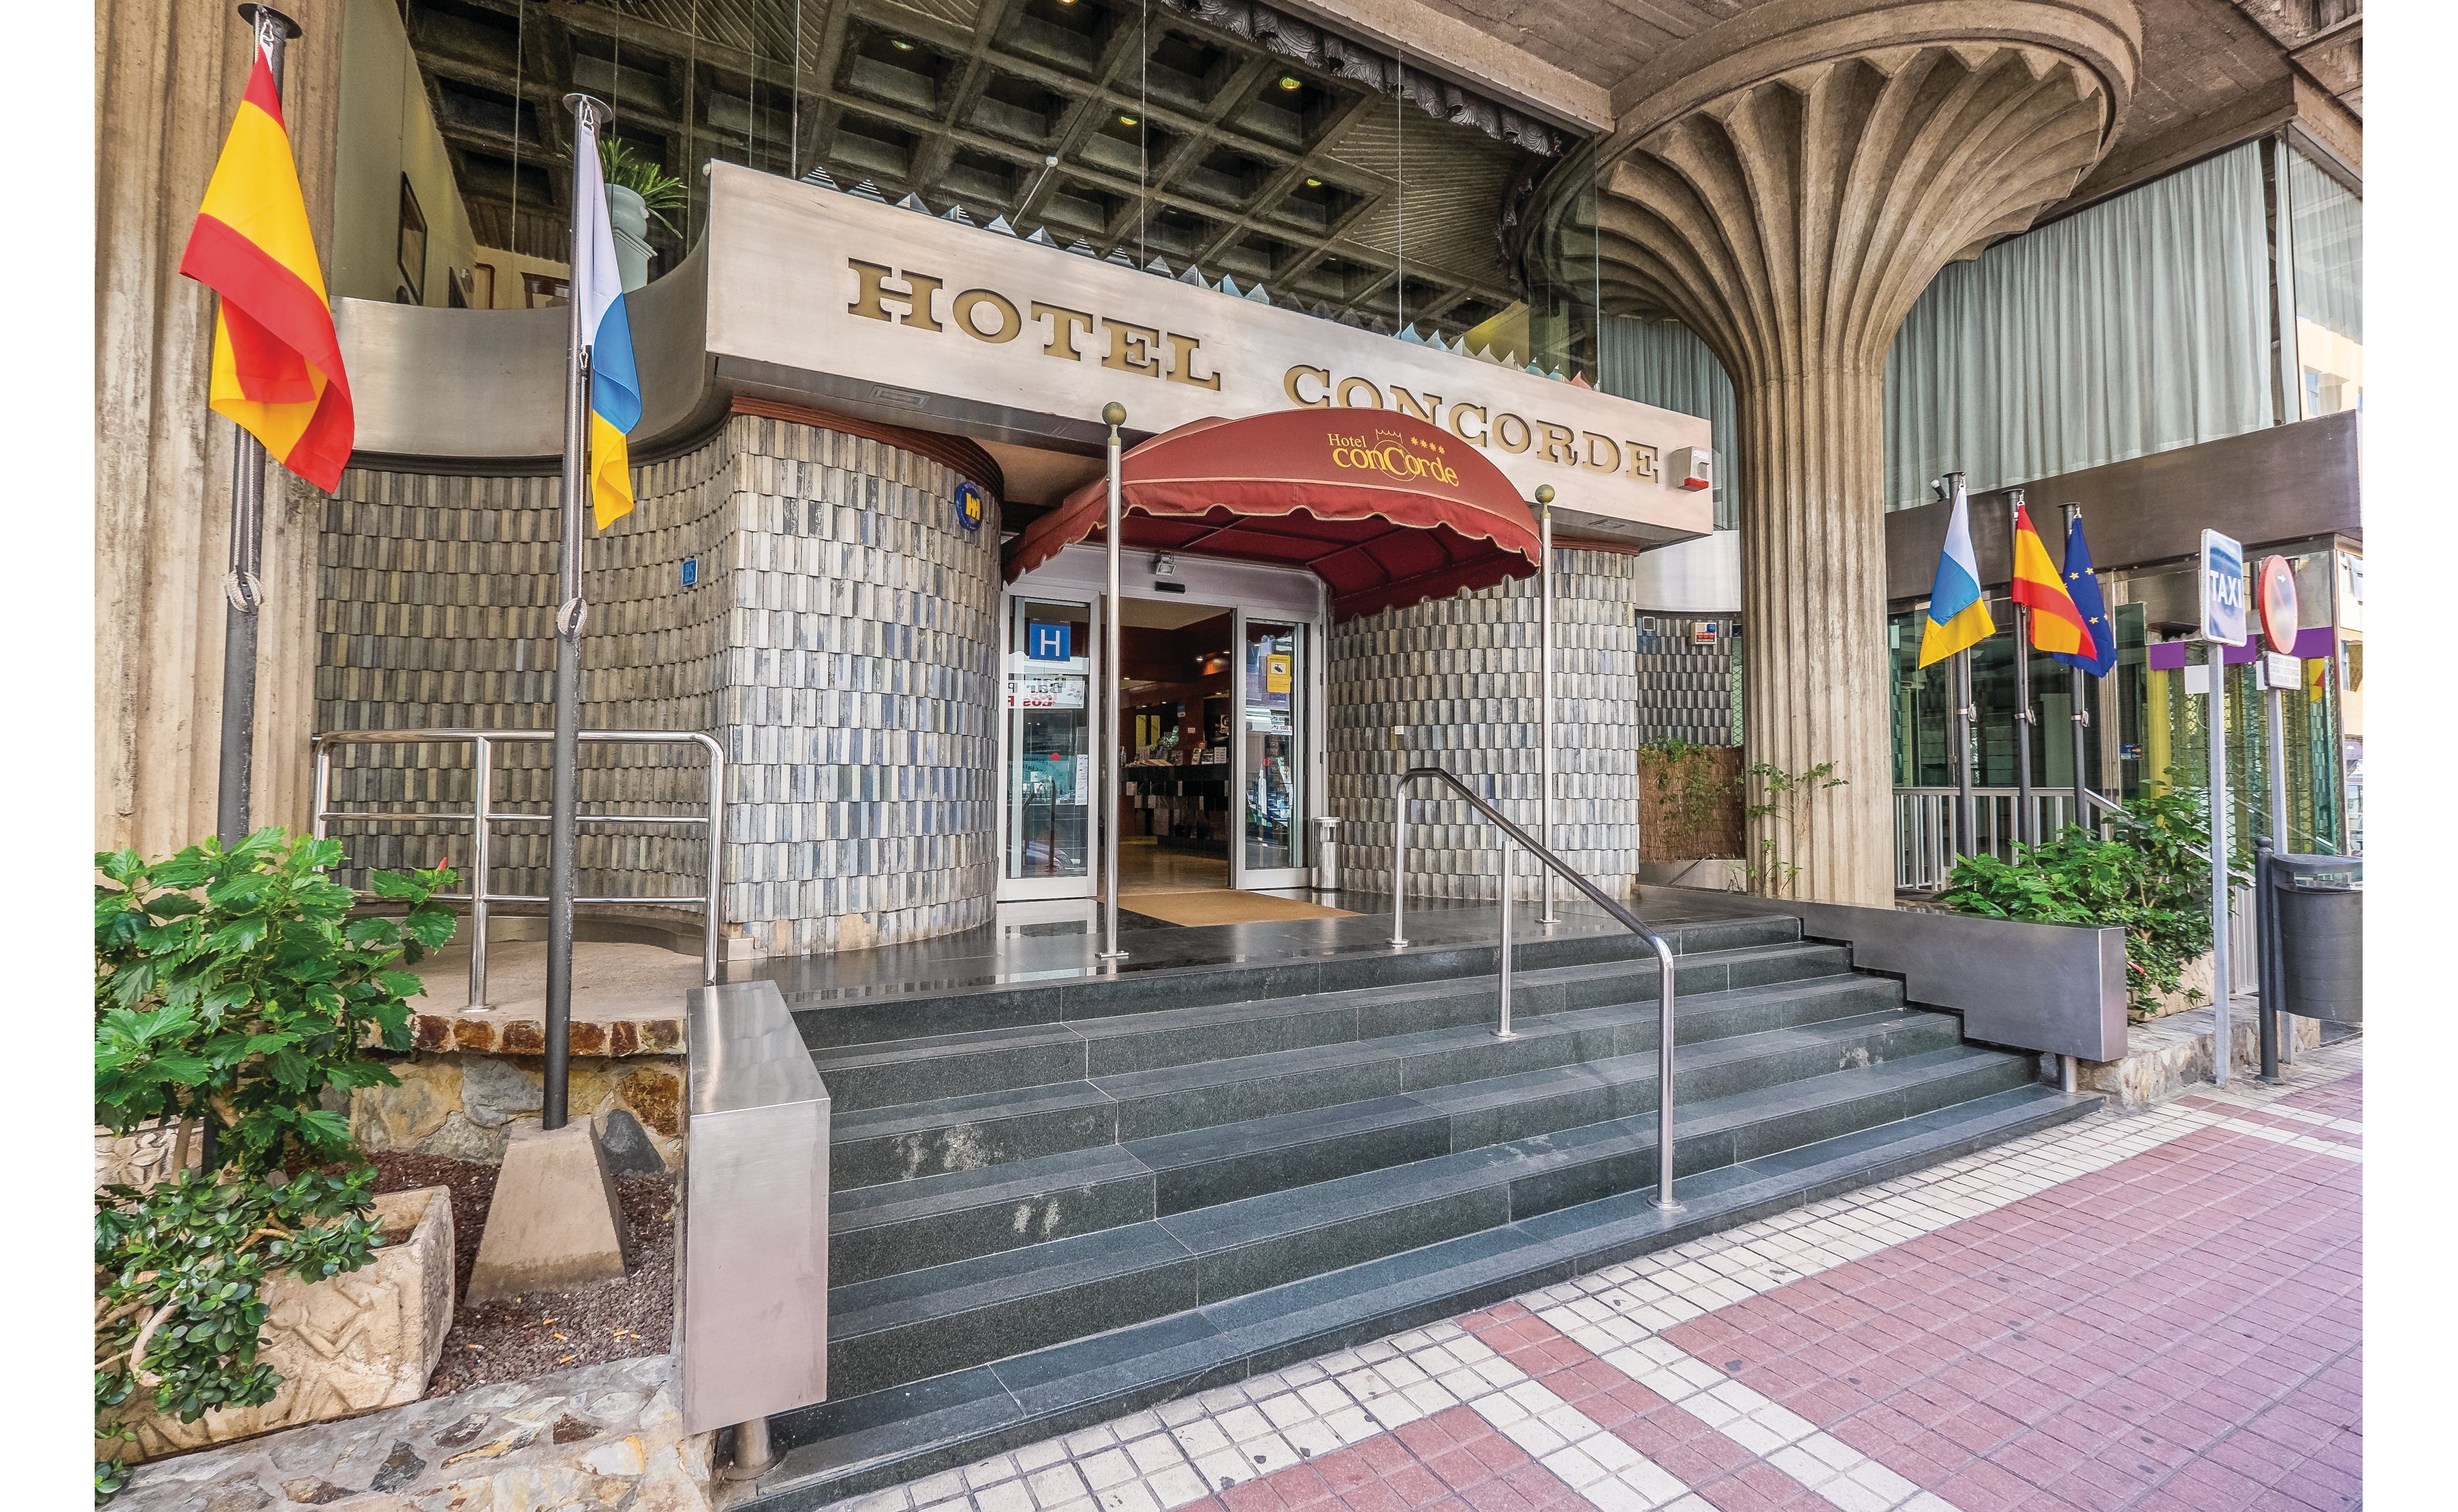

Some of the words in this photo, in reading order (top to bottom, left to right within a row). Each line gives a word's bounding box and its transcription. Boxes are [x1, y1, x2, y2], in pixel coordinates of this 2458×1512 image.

[848, 257, 1221, 391] HOTEL
[1283, 364, 1659, 483] CONCORDE
[1327, 433, 1367, 448] Hotel
[1333, 447, 1459, 487] conCorde
[2209, 569, 2242, 609] TAXI
[1040, 629, 1060, 657] H
